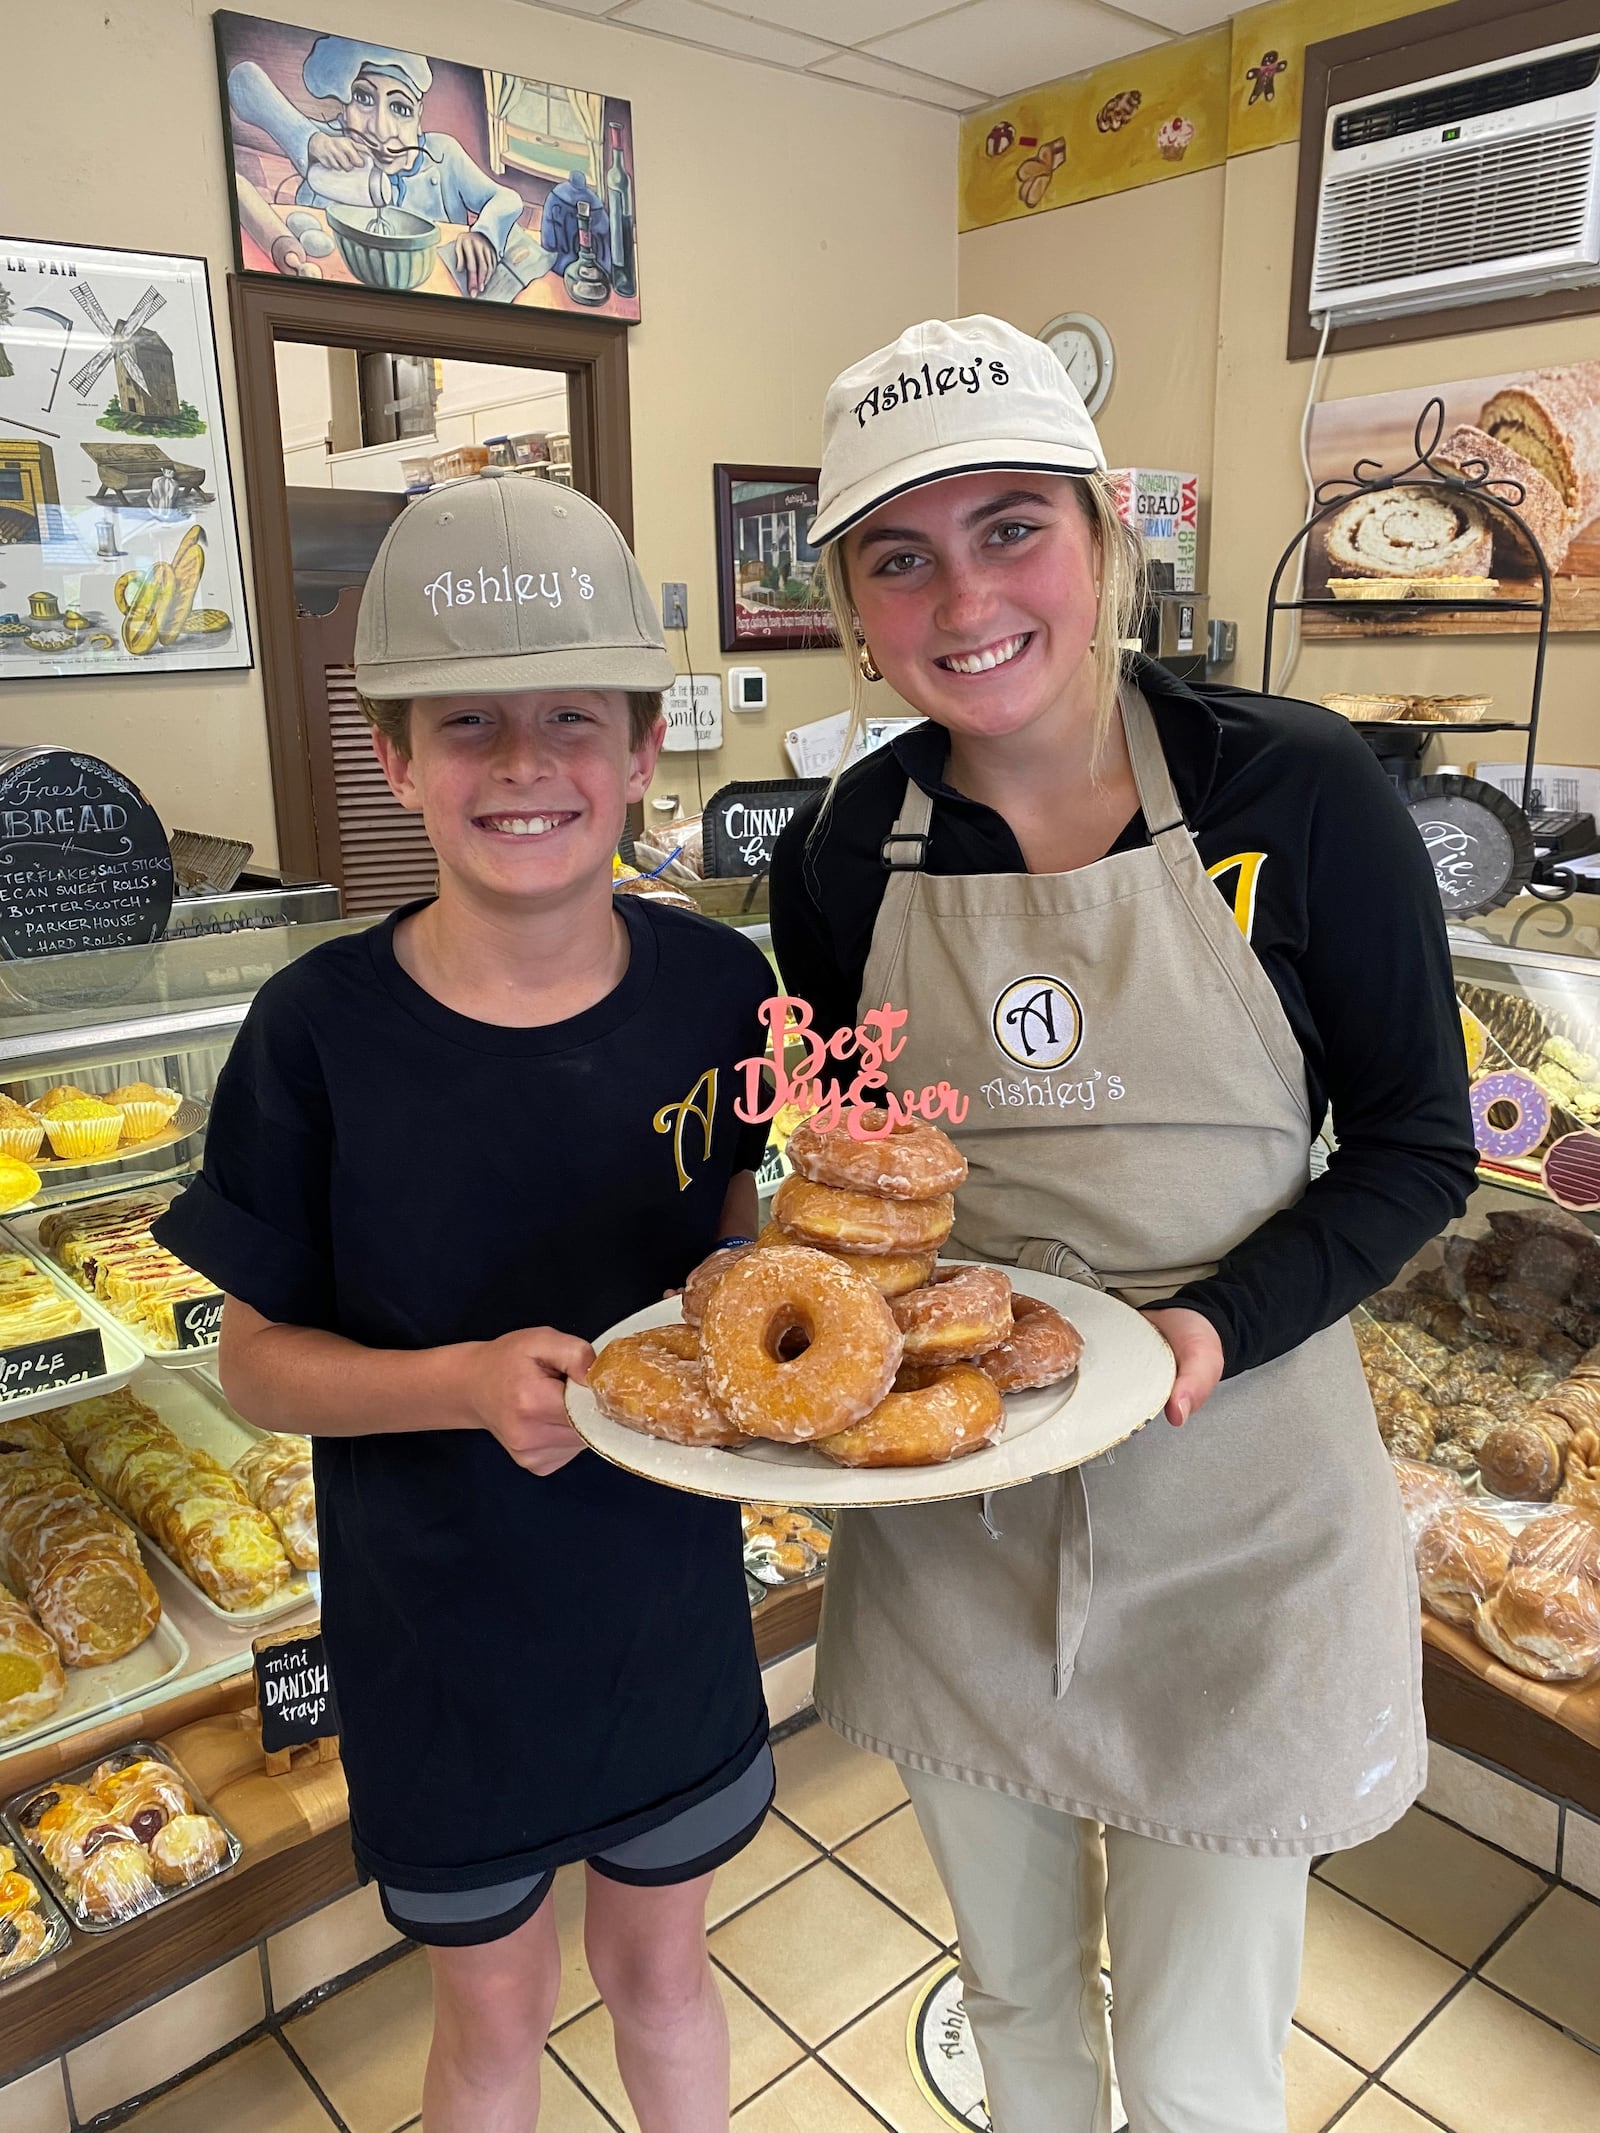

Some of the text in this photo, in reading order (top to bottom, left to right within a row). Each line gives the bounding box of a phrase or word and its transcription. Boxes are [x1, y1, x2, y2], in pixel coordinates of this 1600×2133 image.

[6, 257, 78, 278] LE PAIN
[850, 357, 1009, 429] Ashley's
[1137, 494, 1180, 516] GRAD
[1181, 478, 1198, 529] YAY
[423, 565, 594, 617] Ashley's
[668, 699, 715, 728] smiles
[9, 773, 103, 806] Fresh
[0, 803, 128, 839] BREAD
[721, 803, 794, 839] CINNA
[98, 861, 129, 877] SALT
[131, 856, 172, 871] STICKS
[56, 880, 107, 896] SWEET
[113, 875, 150, 891] ROLLS
[8, 895, 140, 919] BUTTERSCOTCH
[36, 932, 126, 953] HARD ROLLS
[757, 995, 909, 1081] Best
[1006, 988, 1060, 1057] A
[733, 1056, 970, 1142] Day Ever
[979, 1068, 1126, 1111] Ashley's
[652, 1067, 719, 1191] A
[265, 1648, 309, 1674] mini
[265, 1664, 329, 1707] DANISH
[279, 1697, 326, 1726] trays
